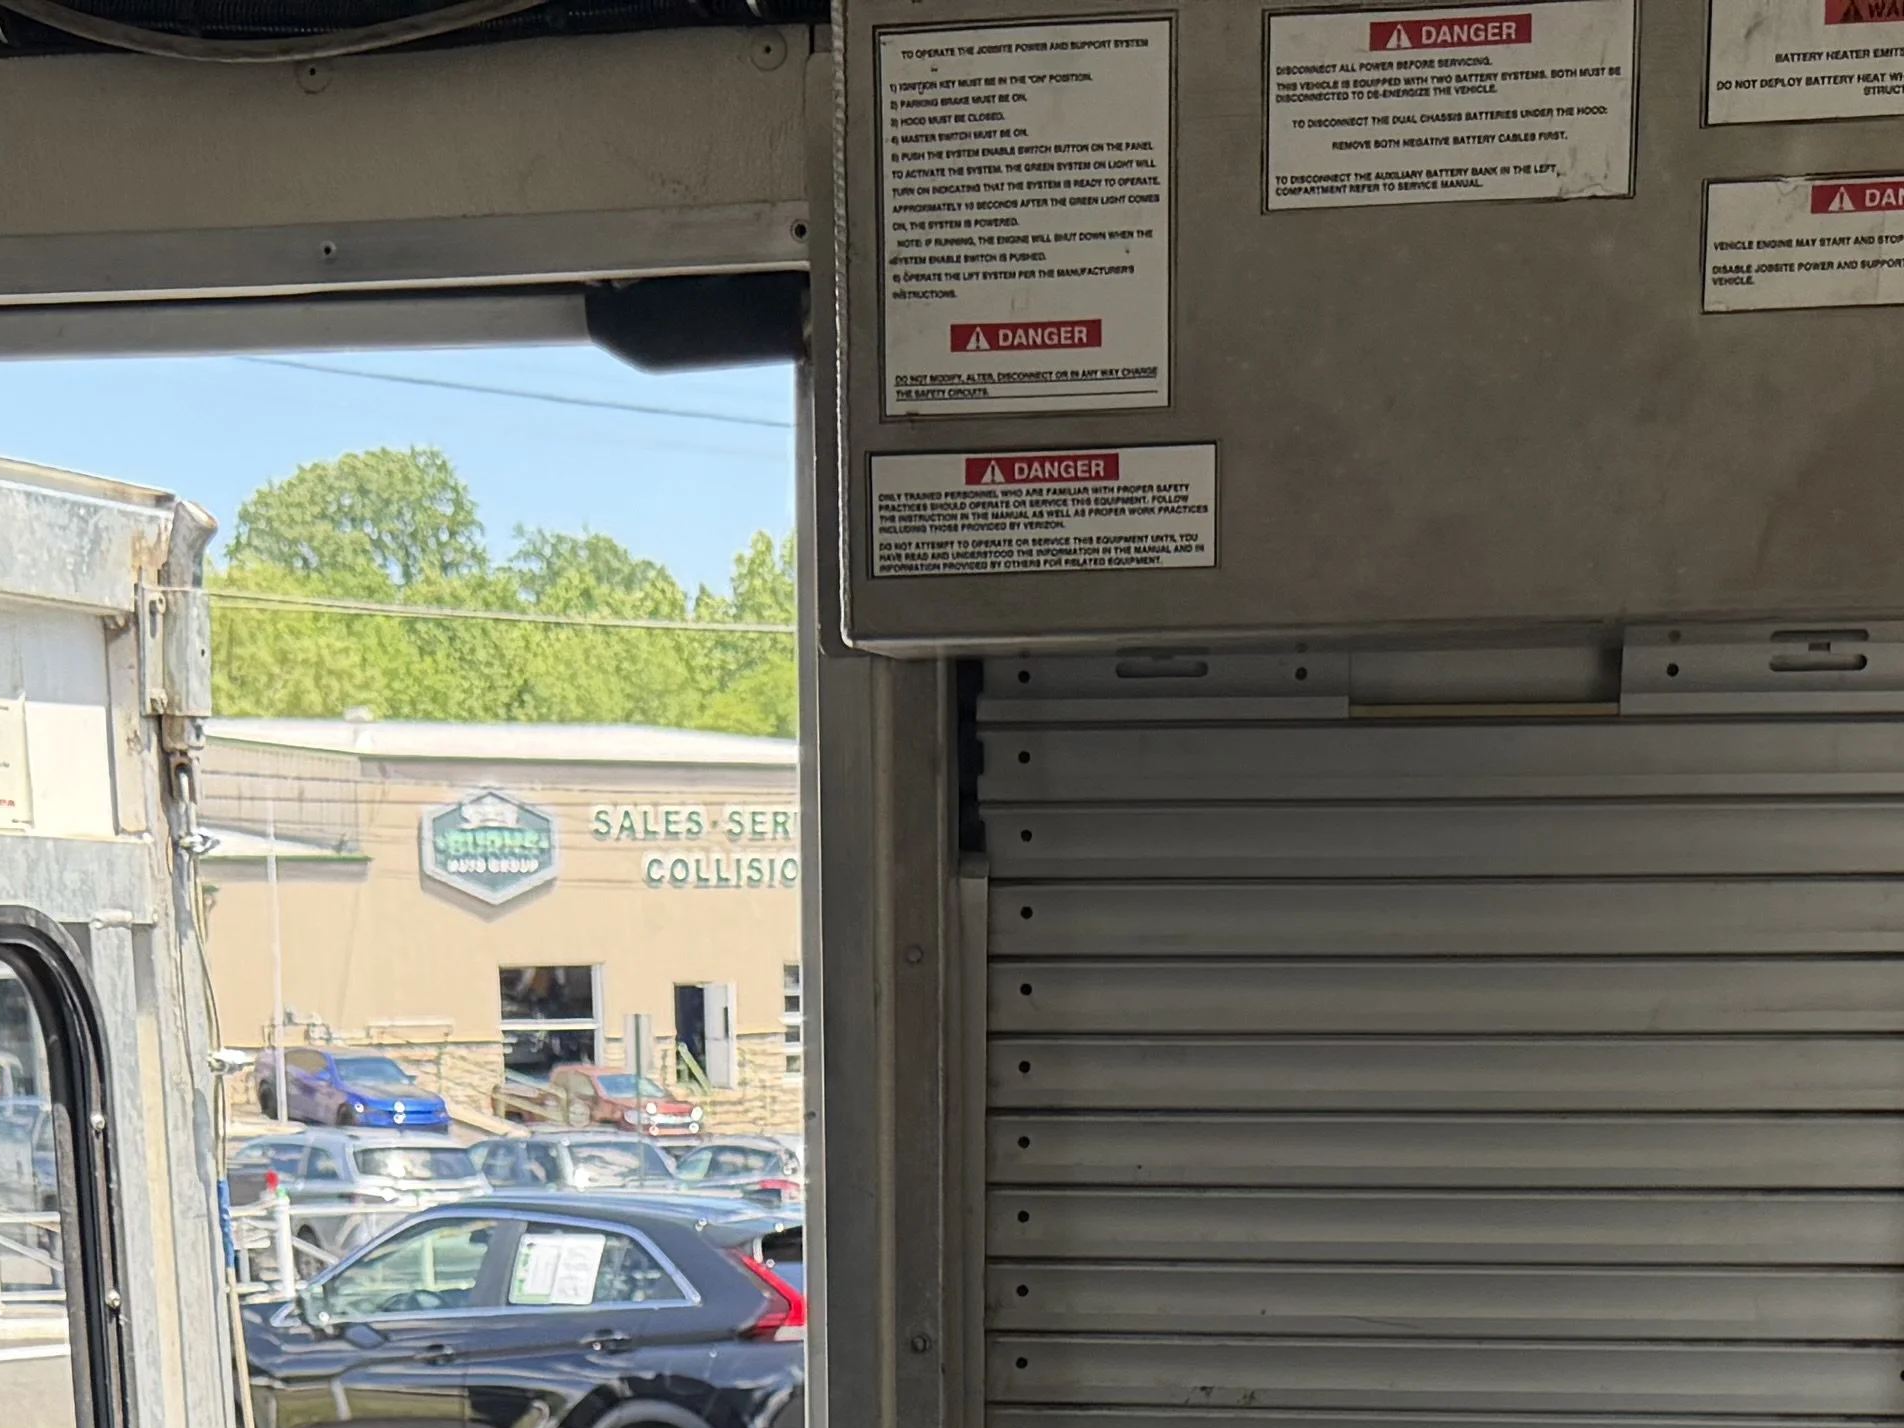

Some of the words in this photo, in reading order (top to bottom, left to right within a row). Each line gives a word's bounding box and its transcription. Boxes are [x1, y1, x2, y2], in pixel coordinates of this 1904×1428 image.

[1422, 22, 1516, 44] DANGER
[1775, 50, 1822, 62] BATTERY
[1826, 48, 1869, 60] HEATER
[1276, 63, 1336, 75] DISCONNECT
[1340, 62, 1355, 73] ALL
[1359, 60, 1393, 72] POWER
[1396, 59, 1434, 70] BEFORE
[1276, 81, 1297, 92] THIS
[1300, 79, 1338, 91] VEHICLE
[1341, 79, 1350, 89] IS
[1352, 76, 1400, 88] EQUIPPED
[1403, 75, 1427, 86] WITH
[1431, 74, 1452, 85] TWO
[1455, 72, 1497, 84] BATTERY
[1550, 68, 1577, 79] BOTH
[1579, 67, 1604, 78] MUST
[1608, 66, 1620, 77] BE
[1716, 79, 1732, 90] DO
[1735, 78, 1756, 89] NOT
[1760, 76, 1801, 88] DEPLOY
[1805, 73, 1853, 86] BATTERY
[1857, 72, 1885, 84] HEAT
[1276, 91, 1348, 103] DISCONNECTED
[1352, 90, 1363, 100] TO
[1367, 87, 1430, 99] DE-ENERGIZE
[1433, 86, 1451, 96] THE
[1292, 119, 1305, 129] TO
[1307, 116, 1367, 128] DISCONNECT
[1372, 115, 1389, 126] THE
[1392, 114, 1416, 125] DUAL
[1420, 112, 1462, 123] CHASSIS
[1465, 109, 1517, 121] BATTERIES
[1520, 108, 1553, 119] UNDER
[1556, 107, 1574, 117] THE
[1332, 139, 1370, 151] REMOVE
[1374, 138, 1400, 149] BOTH
[1402, 136, 1449, 148] NEGATIVE
[1452, 134, 1495, 145] BATTERY
[1498, 132, 1535, 143] CABLES
[1276, 175, 1287, 185] TO
[1290, 172, 1350, 185] DISCONNECT
[1354, 171, 1371, 182] THE
[1375, 169, 1422, 181] AUXILIARY
[1426, 167, 1467, 178] BATTERY
[1471, 165, 1497, 176] BANK
[1500, 165, 1510, 175] IN
[1513, 164, 1531, 174] THE
[1276, 184, 1346, 197] COMPARTMENT
[1349, 183, 1379, 193] REFER
[1383, 182, 1394, 192] TO
[1398, 180, 1437, 191] SERVICE
[1713, 239, 1753, 251] VEHICLE
[1756, 238, 1792, 250] ENGINE
[1795, 237, 1815, 248] MAY
[1819, 236, 1849, 247] START
[1854, 235, 1874, 246] AND
[1877, 234, 1903, 245] STOP
[1712, 263, 1752, 275] DISABLE
[1755, 261, 1794, 273] JOBSITE
[1797, 260, 1834, 272] POWER
[1837, 259, 1857, 270] AND
[998, 326, 1087, 347] DANGER
[1014, 460, 1104, 479] DANGER
[593, 809, 704, 838] SALES
[727, 810, 799, 840] SER
[488, 858, 540, 874] GROUP
